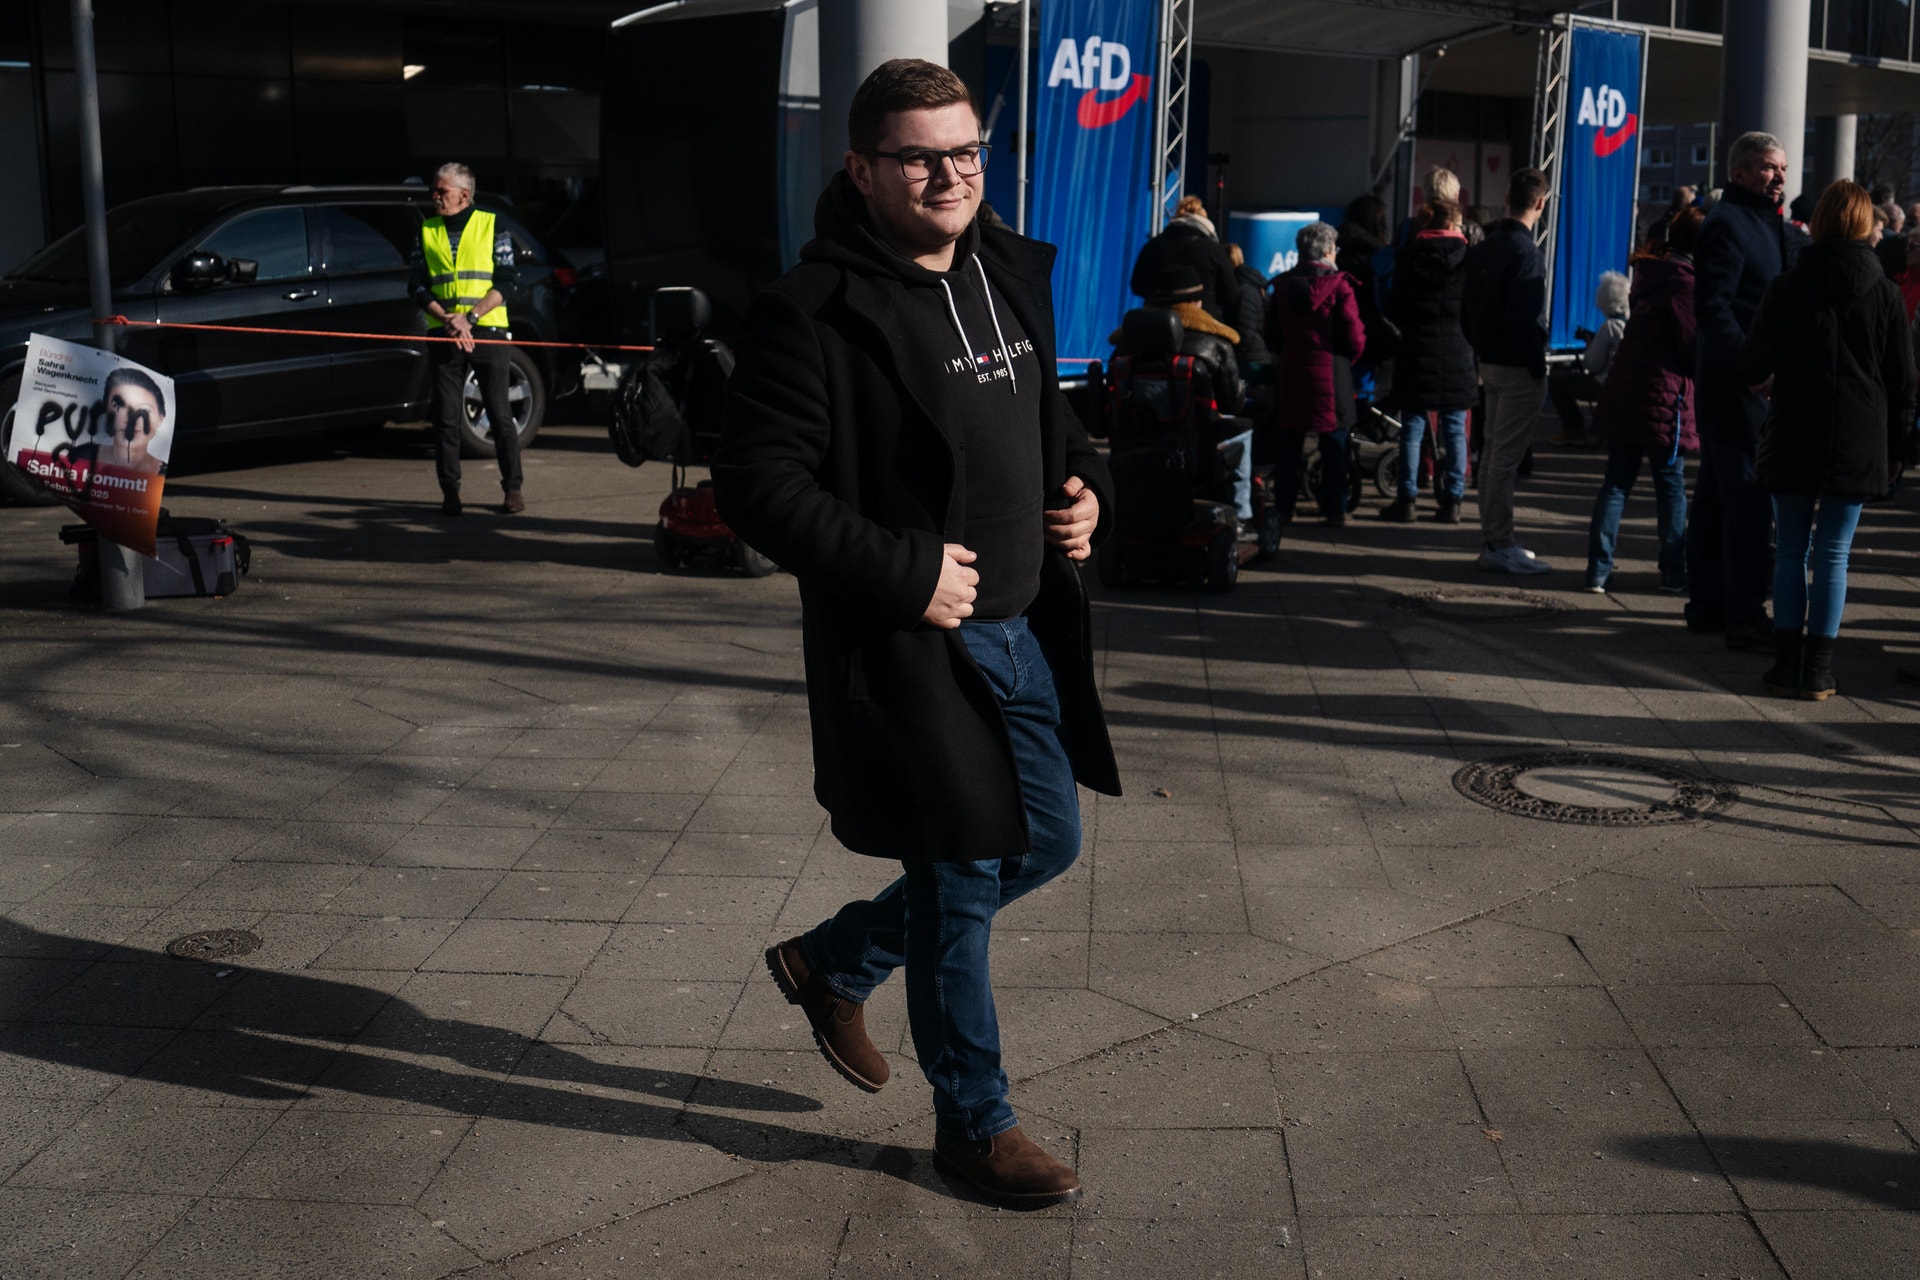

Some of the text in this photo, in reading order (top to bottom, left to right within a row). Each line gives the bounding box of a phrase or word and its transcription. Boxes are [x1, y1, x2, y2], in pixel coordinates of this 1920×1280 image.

[1047, 35, 1131, 91] AfD
[1577, 84, 1627, 128] AfD
[38, 358, 65, 370] Sahra
[37, 366, 98, 385] Wagenknecht
[977, 367, 1009, 384] EST. 1985
